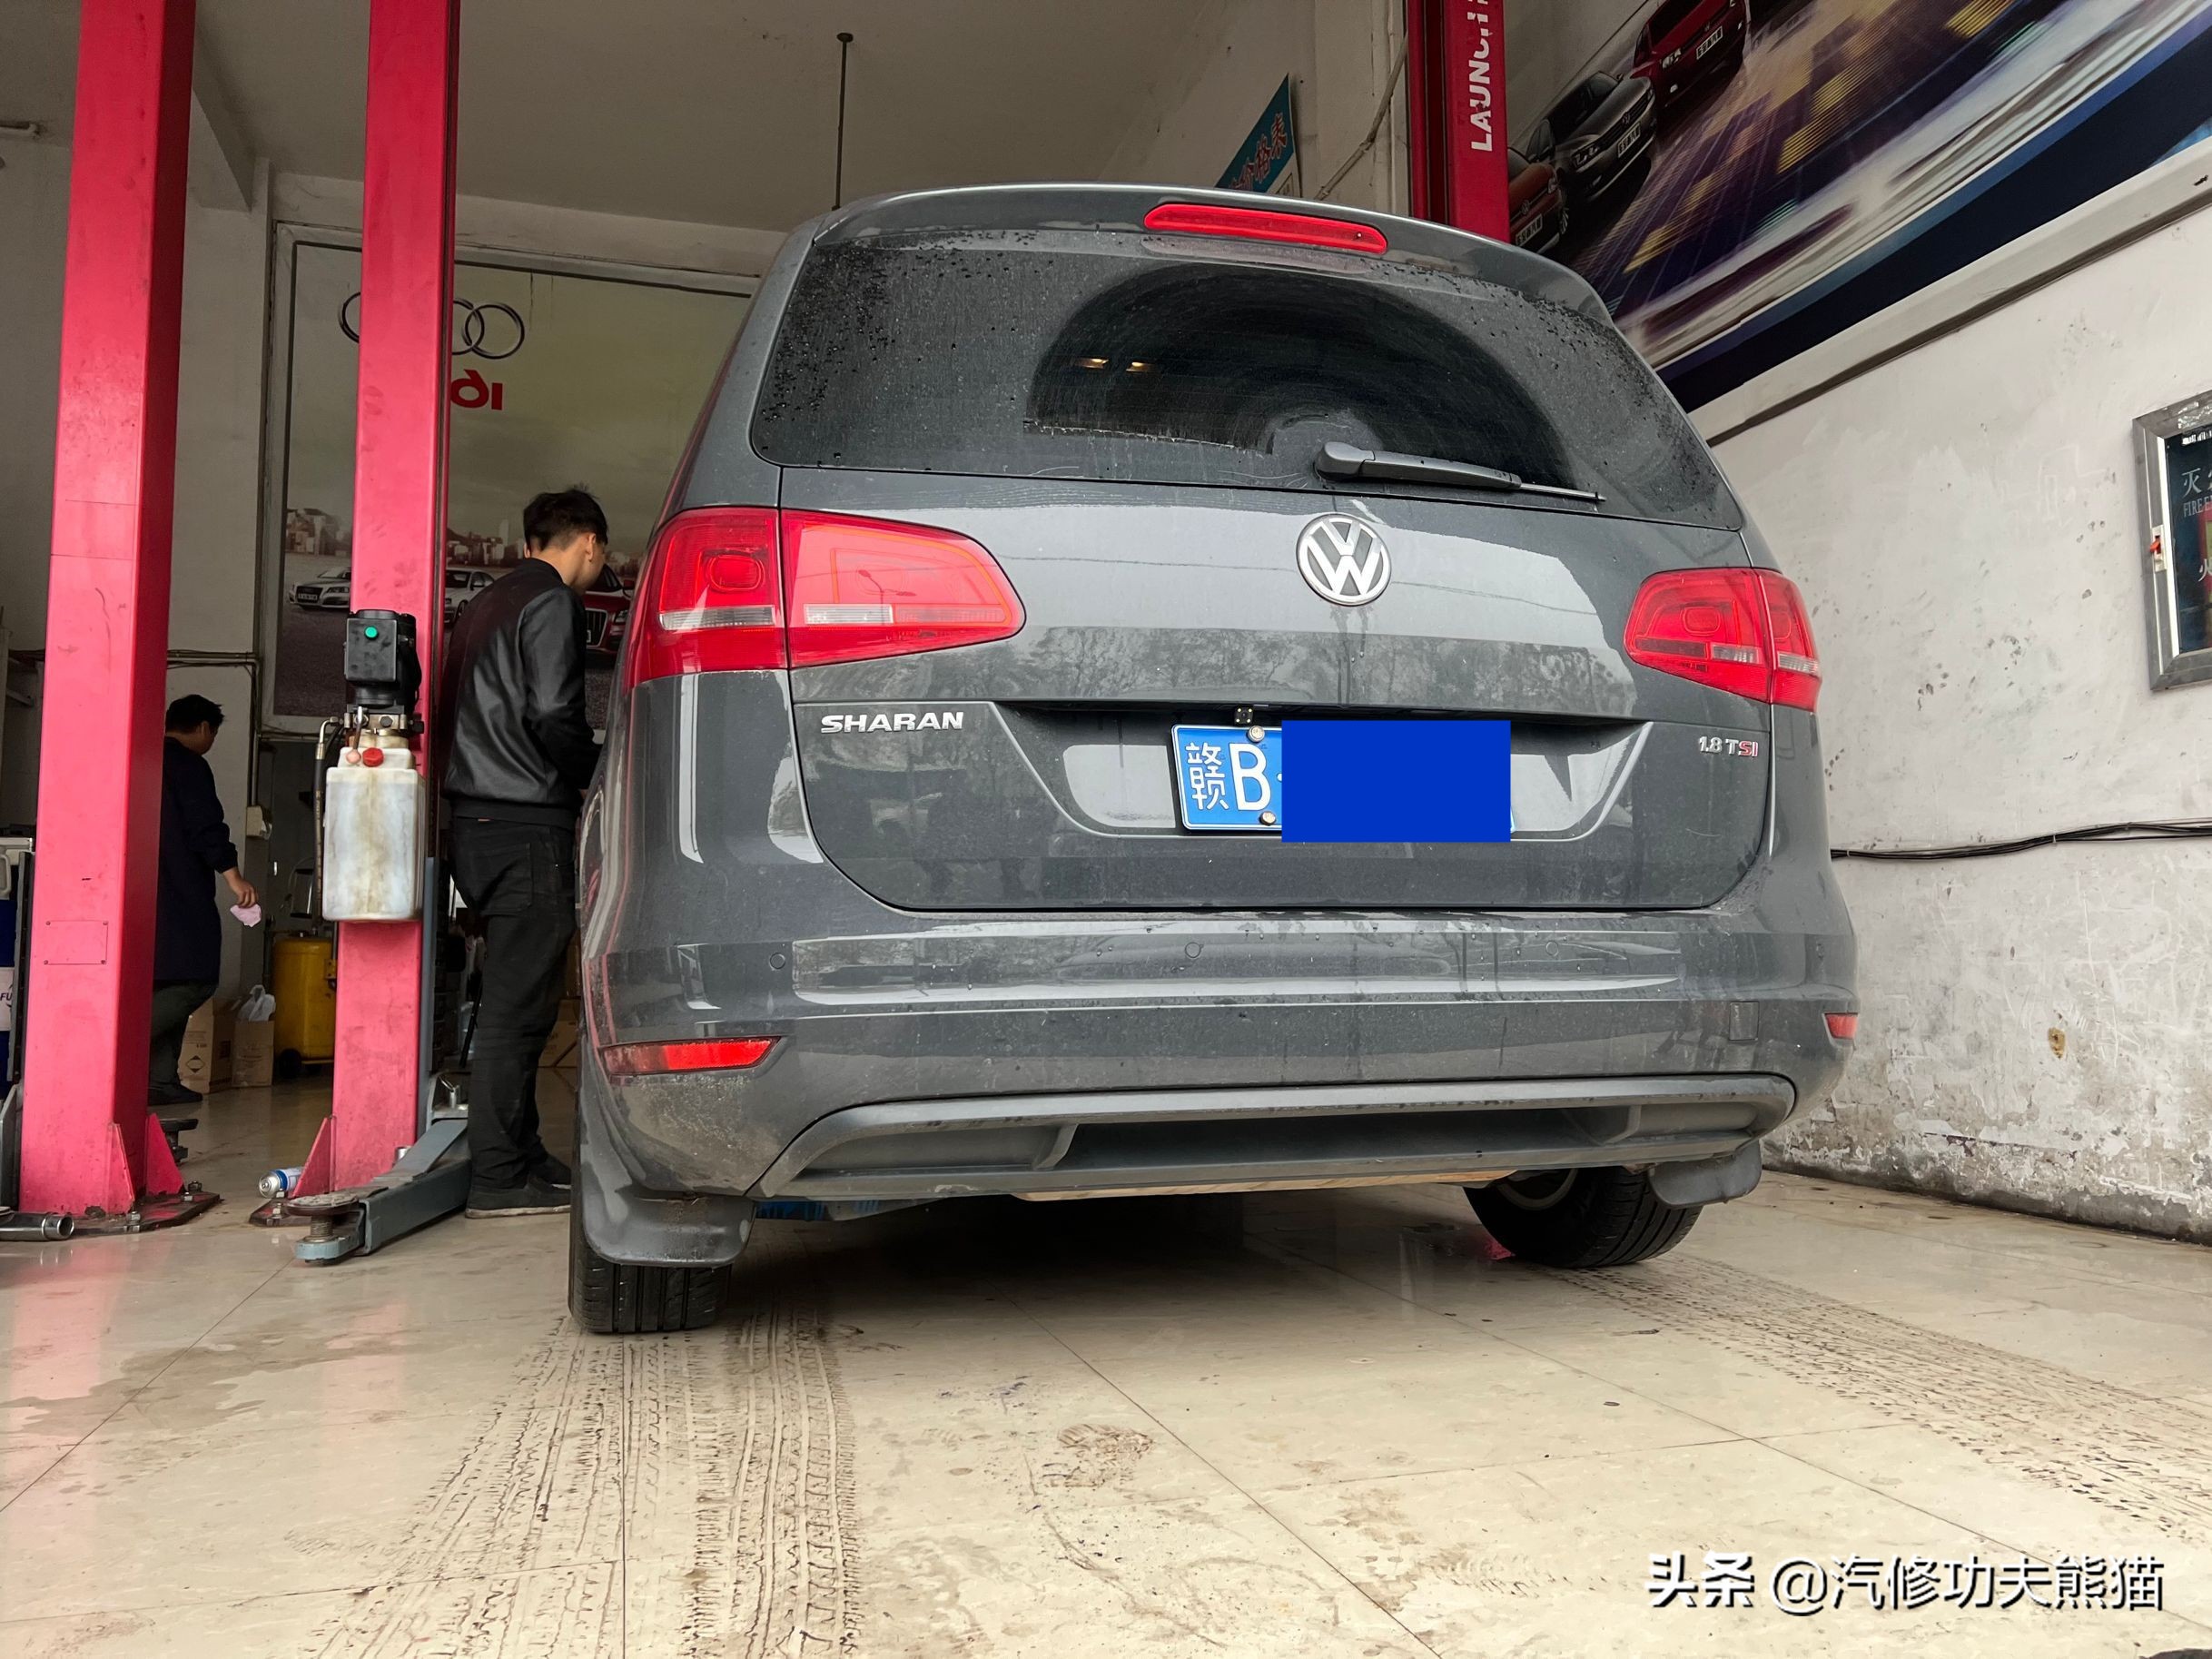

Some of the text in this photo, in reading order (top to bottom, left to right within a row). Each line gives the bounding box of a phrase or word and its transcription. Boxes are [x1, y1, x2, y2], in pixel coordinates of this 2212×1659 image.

[1229, 113, 1288, 189] 价格表
[451, 369, 503, 410] di
[821, 711, 964, 734] SHARAN
[1699, 736, 1759, 757] 1.8 TSI
